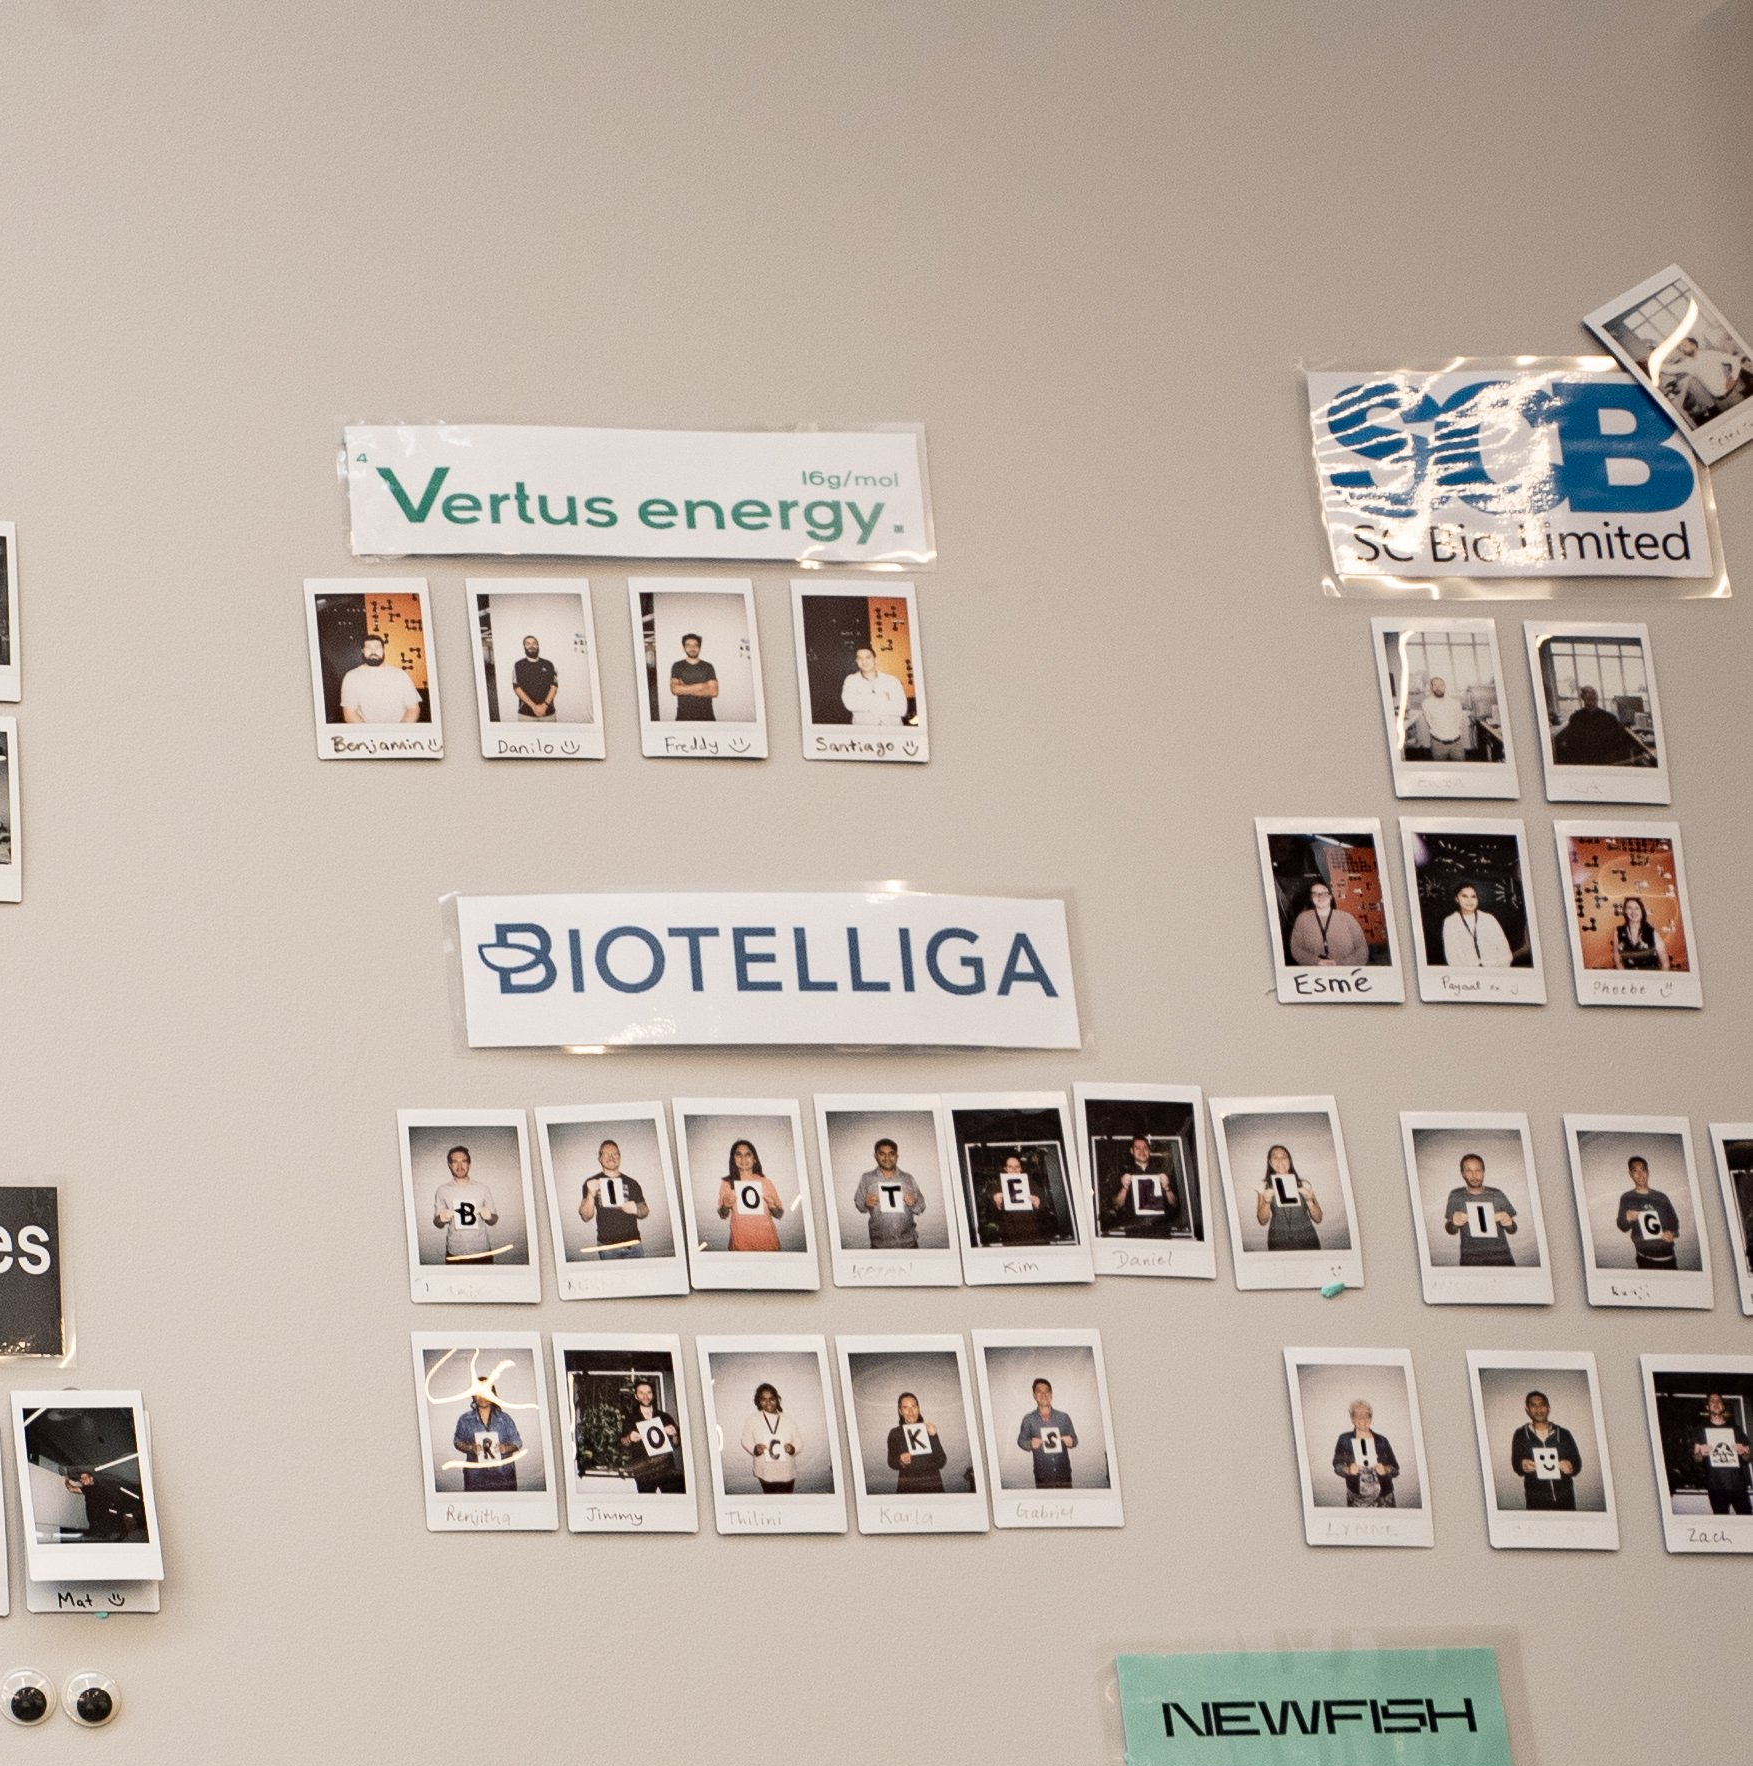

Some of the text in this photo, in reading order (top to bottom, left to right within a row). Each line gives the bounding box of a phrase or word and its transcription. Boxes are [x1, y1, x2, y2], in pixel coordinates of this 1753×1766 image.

[375, 465, 619, 529] Vertus
[497, 738, 555, 756] Danilo
[815, 736, 895, 756] Santiago
[477, 921, 1060, 999] BIOTELLIGA
[1293, 967, 1374, 996] Esmé
[1002, 1259, 1040, 1275] Kim
[1112, 1250, 1173, 1270] Daniel
[56, 1590, 95, 1610] Mat
[1161, 1697, 1478, 1738] NEWFISH
